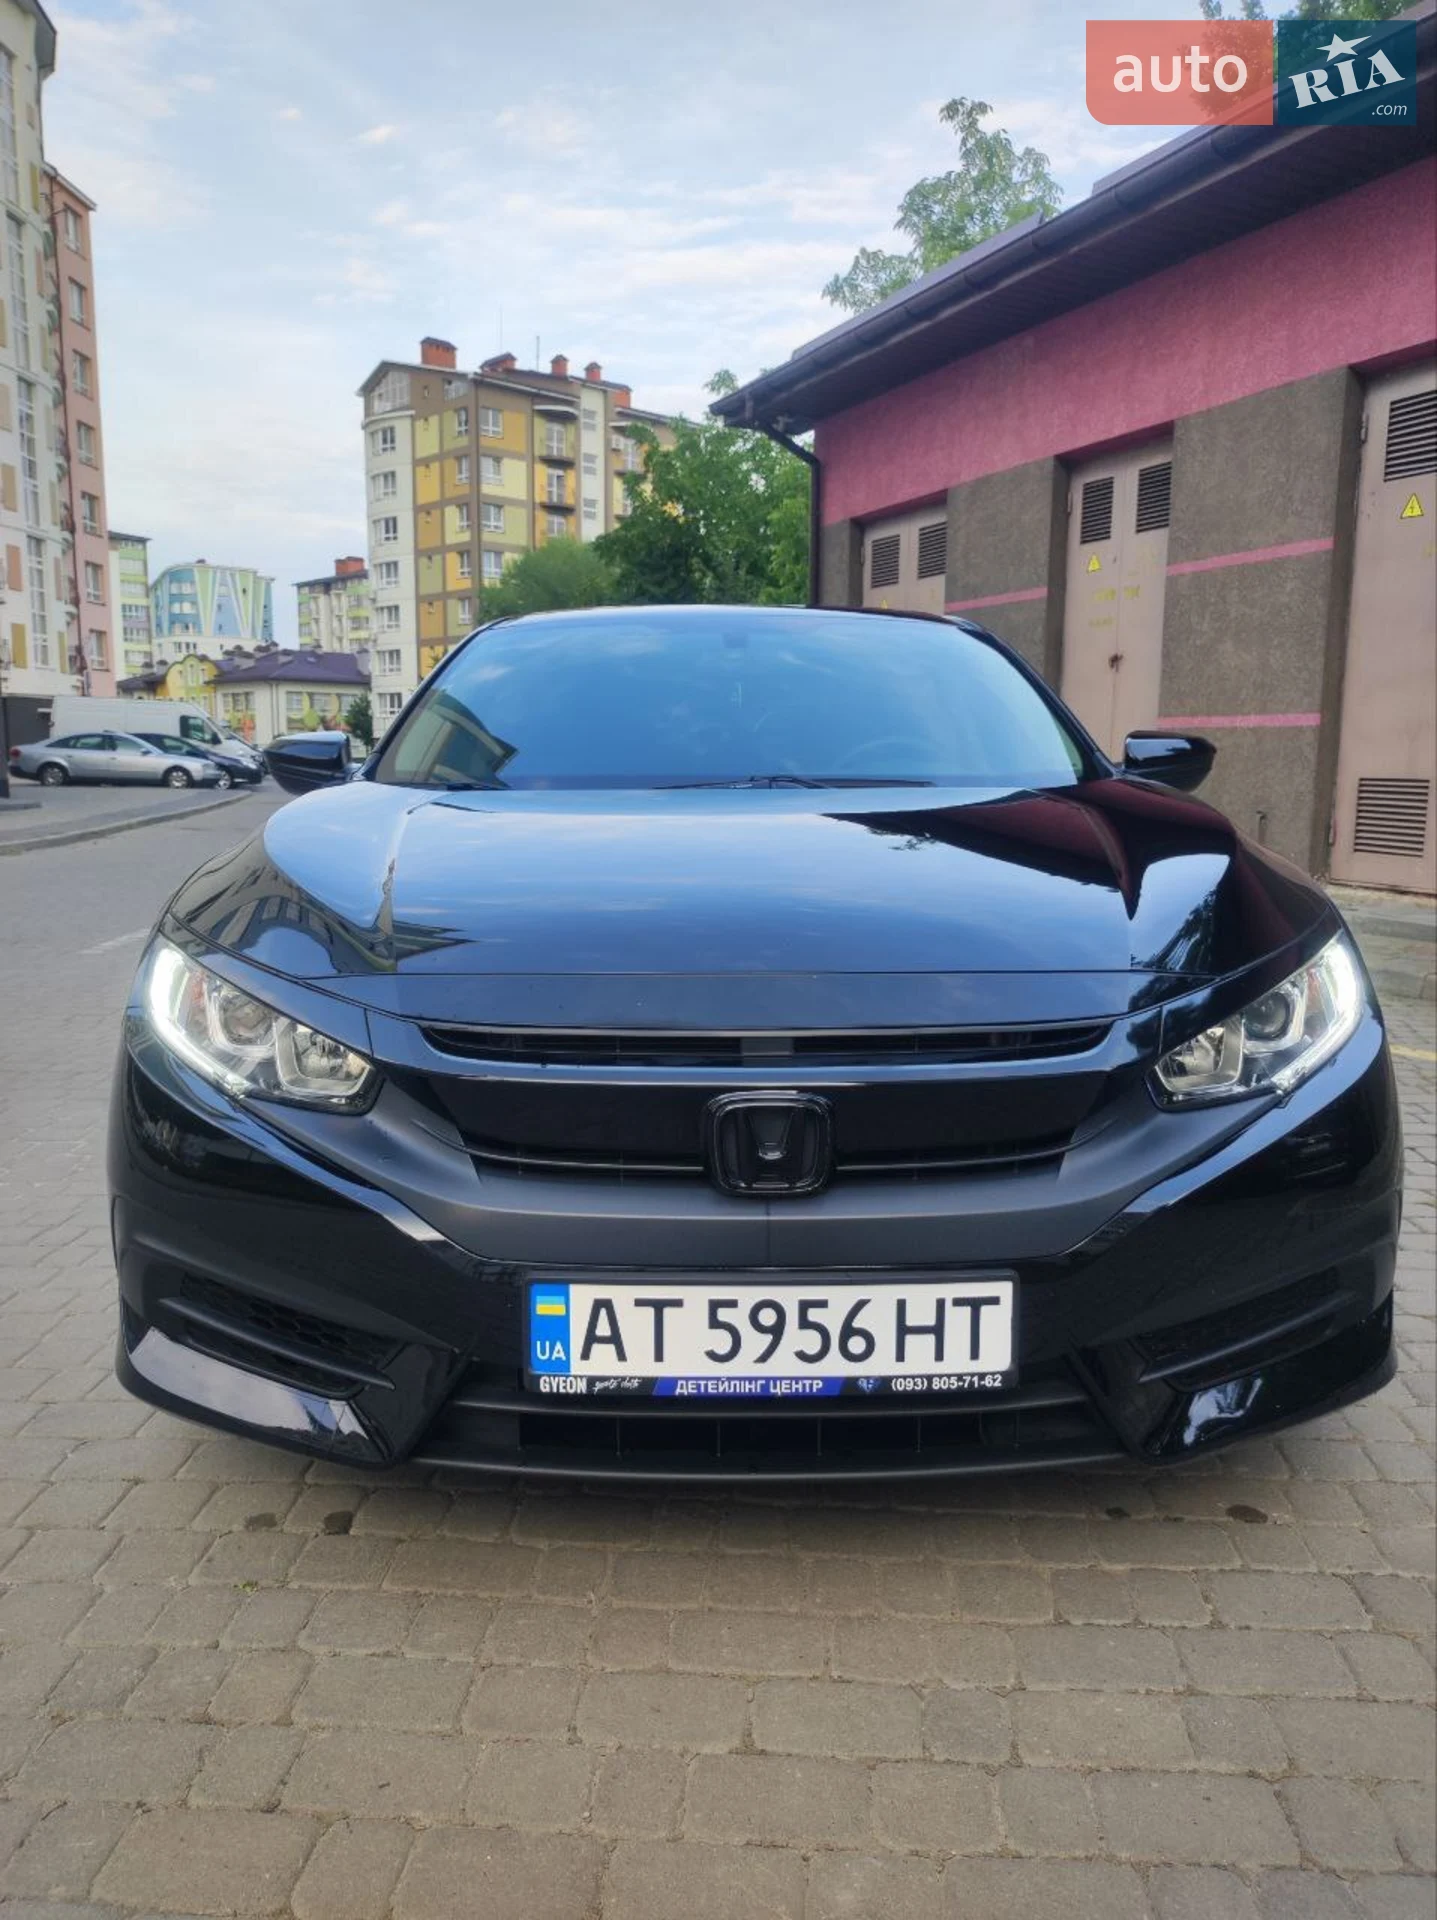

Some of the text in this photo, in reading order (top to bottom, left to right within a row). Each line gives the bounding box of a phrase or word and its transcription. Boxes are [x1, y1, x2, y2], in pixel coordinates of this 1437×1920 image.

[580, 1296, 1001, 1364] AT 5956 HT
[536, 1340, 566, 1361] UA
[539, 1376, 587, 1394] GYEON
[675, 1378, 823, 1396] ДЕТЕЙЛІНГ ЦЕНТР
[891, 1374, 1003, 1391] (093) 805-71-62
